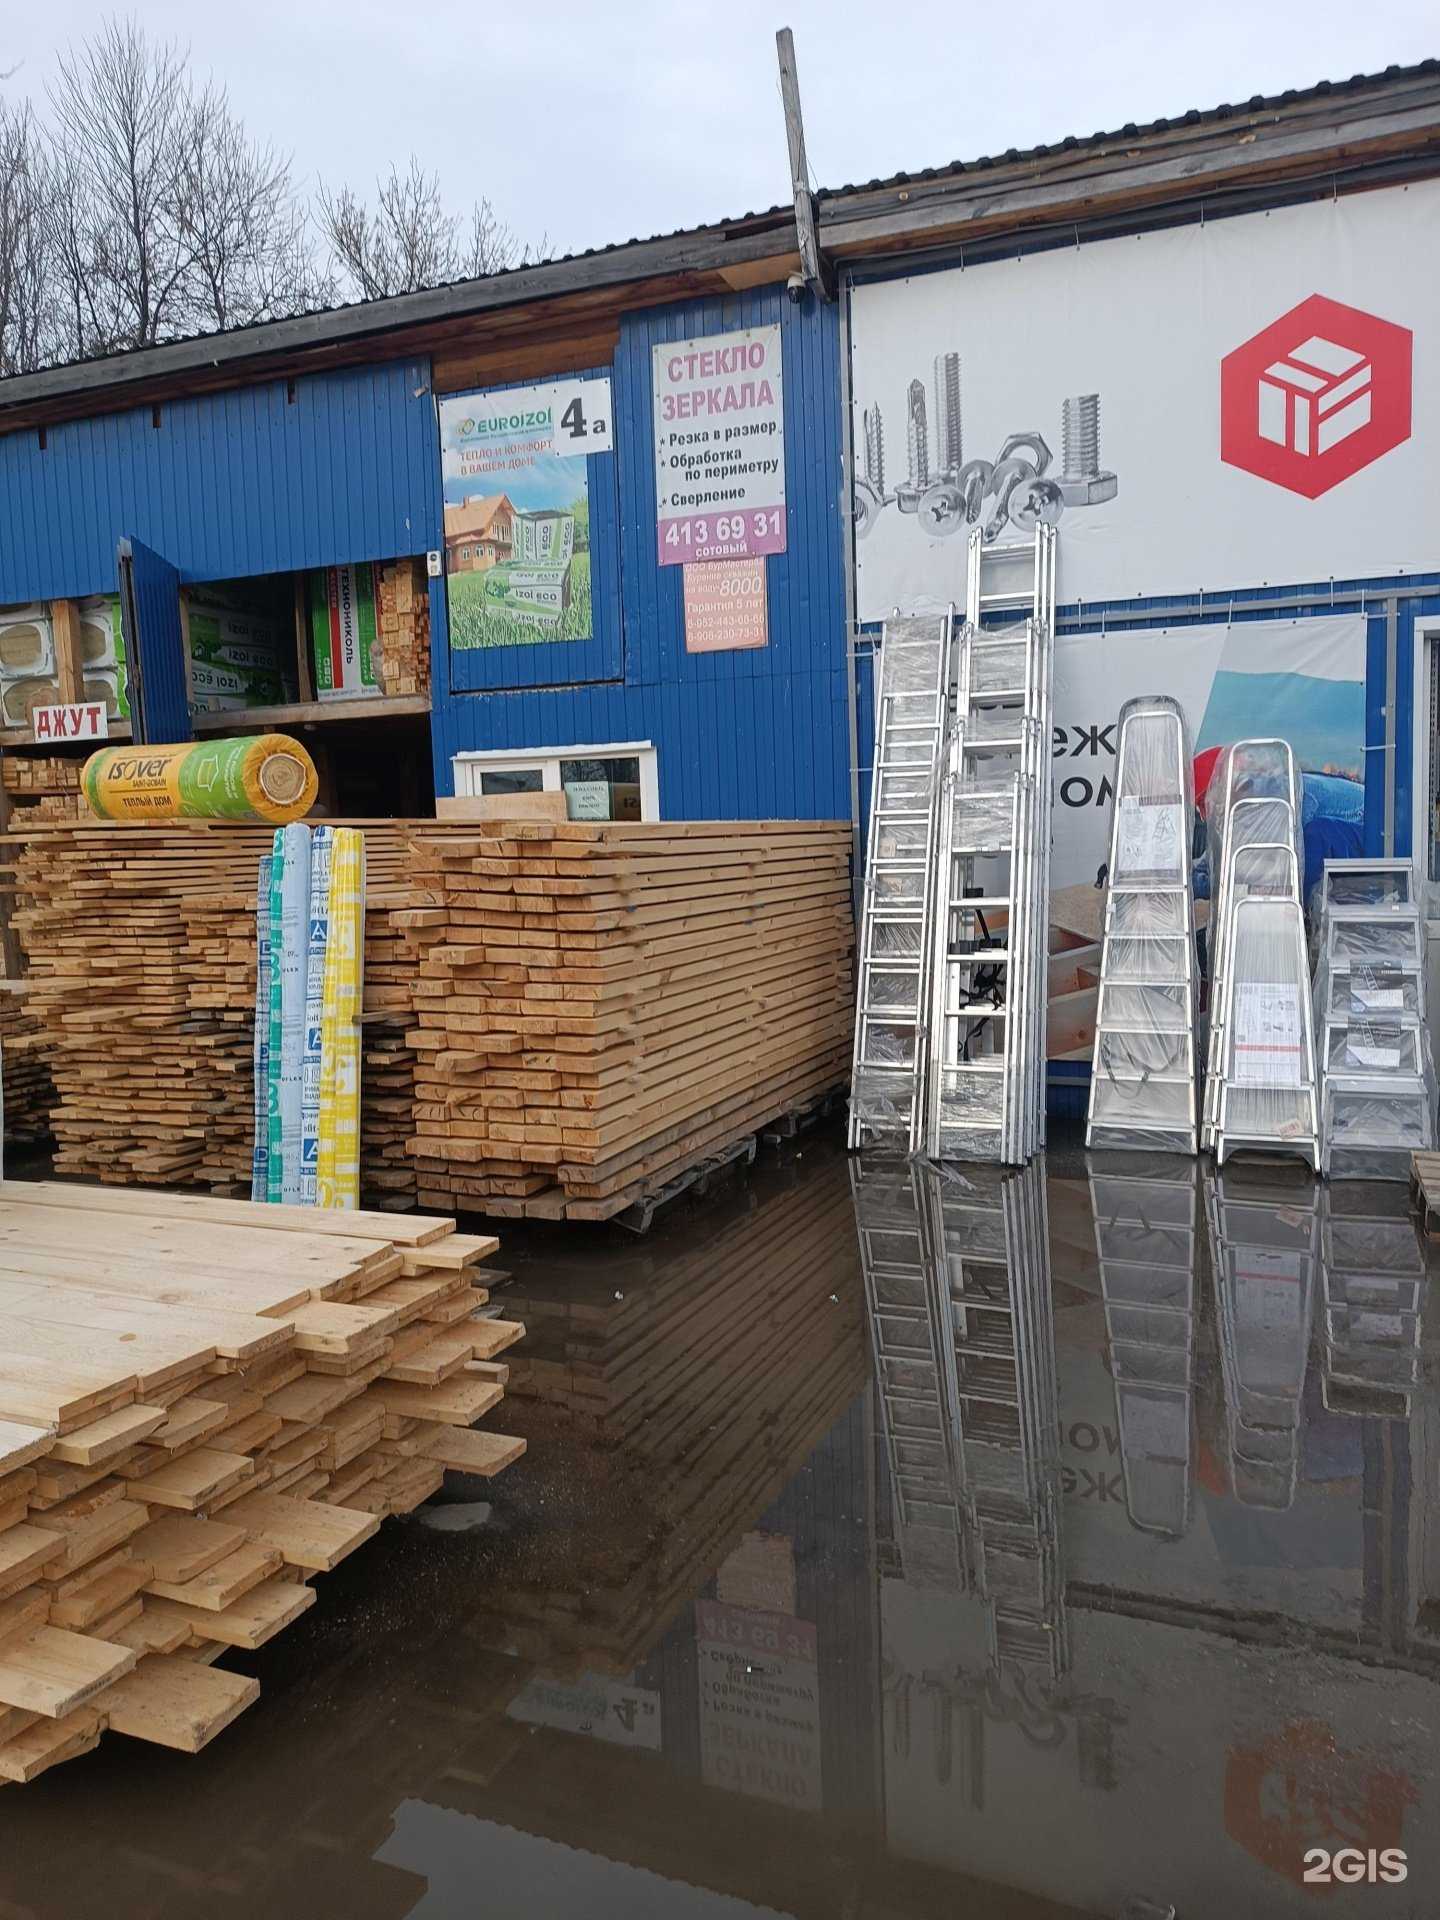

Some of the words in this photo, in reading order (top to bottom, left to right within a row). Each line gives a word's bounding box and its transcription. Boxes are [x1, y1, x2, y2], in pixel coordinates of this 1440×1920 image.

[668, 341, 766, 383] СТЕКЛО
[662, 380, 775, 421] ЗЕРКАЛА
[669, 430, 709, 446] Резка
[713, 430, 721, 441] в
[725, 420, 777, 442] размер
[461, 446, 493, 461] ТЕПЛО
[670, 448, 742, 469] Обработка
[685, 469, 701, 481] по
[704, 458, 779, 480] периметру
[671, 487, 746, 507] Сверление
[665, 519, 709, 547] 413
[716, 515, 746, 541] 69
[753, 510, 781, 537] 31
[695, 540, 747, 558] сотовый
[719, 575, 762, 597] 8000
[37, 706, 101, 738] ДЖУТ
